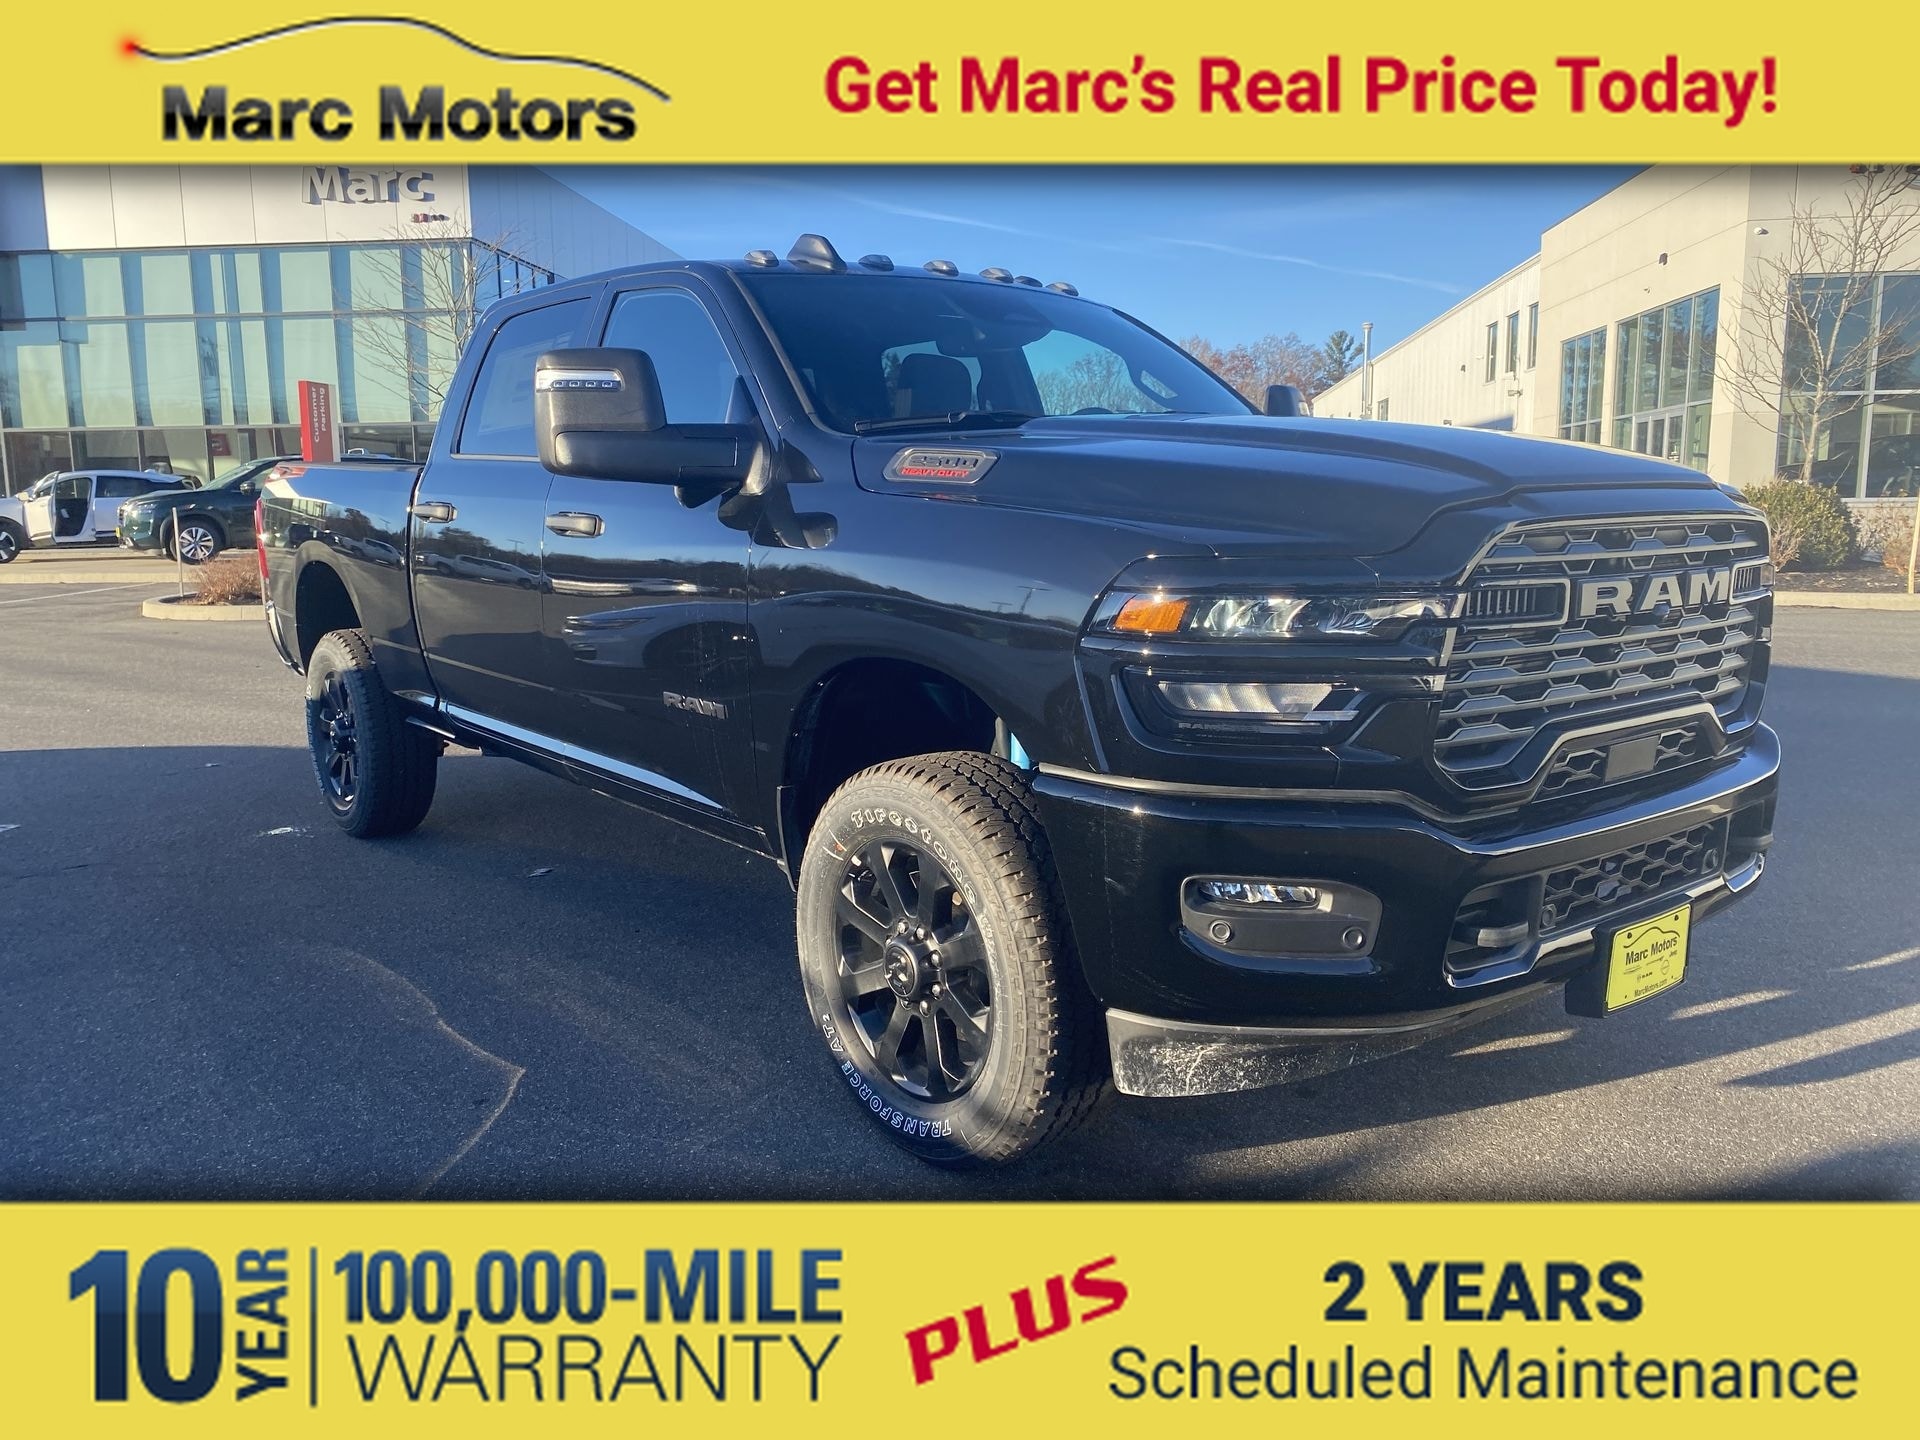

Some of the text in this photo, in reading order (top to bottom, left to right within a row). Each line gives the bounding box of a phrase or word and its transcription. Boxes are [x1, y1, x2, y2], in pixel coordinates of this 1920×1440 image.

[302, 166, 432, 203] Marc
[901, 467, 969, 478] HEAVY DUTY
[1578, 567, 1730, 618] RAM
[663, 692, 728, 720] RAM
[851, 808, 978, 905] Firestone
[1625, 949, 1648, 965] Marc
[1650, 936, 1678, 956] Motors
[1634, 979, 1667, 997] MarcMotors.com
[841, 1060, 952, 1138] TRANSFORCE
